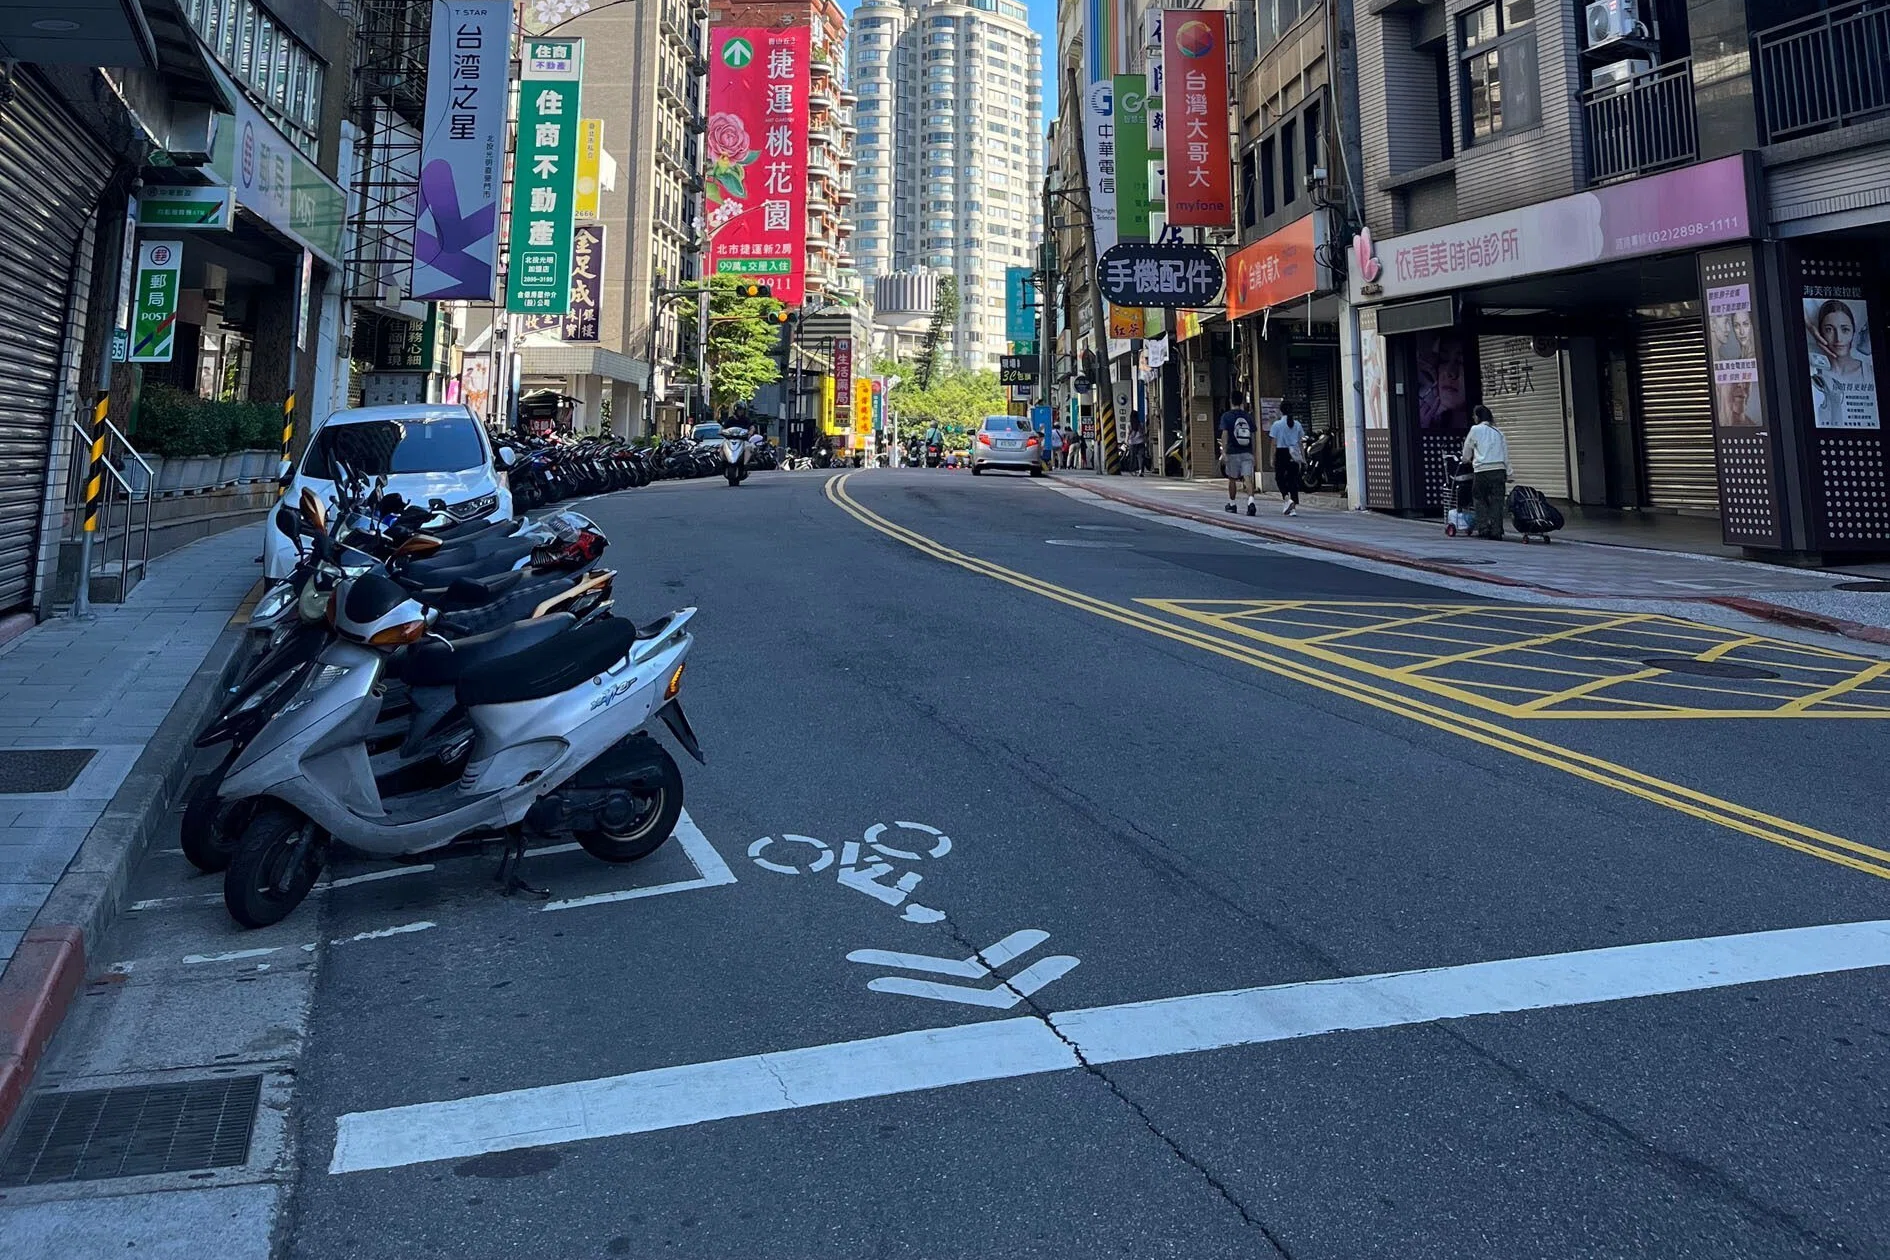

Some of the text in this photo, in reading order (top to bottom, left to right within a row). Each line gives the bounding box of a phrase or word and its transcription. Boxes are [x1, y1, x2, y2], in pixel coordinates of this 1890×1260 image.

[535, 44, 568, 59] 住商
[764, 47, 795, 231] 捷運桃花園
[1185, 70, 1210, 188] 台灣大哥大
[529, 90, 563, 246] 住商不動產
[1098, 124, 1115, 194] 中華電信
[1175, 200, 1225, 214] myfone
[1648, 216, 1739, 244] (02)2898-1111
[1248, 253, 1280, 290] 台灣大哥大
[1395, 228, 1519, 282] 依嘉美時尚診所
[147, 273, 168, 307] 郵局
[1106, 258, 1213, 294] 手機配件
[141, 312, 168, 321] POST
